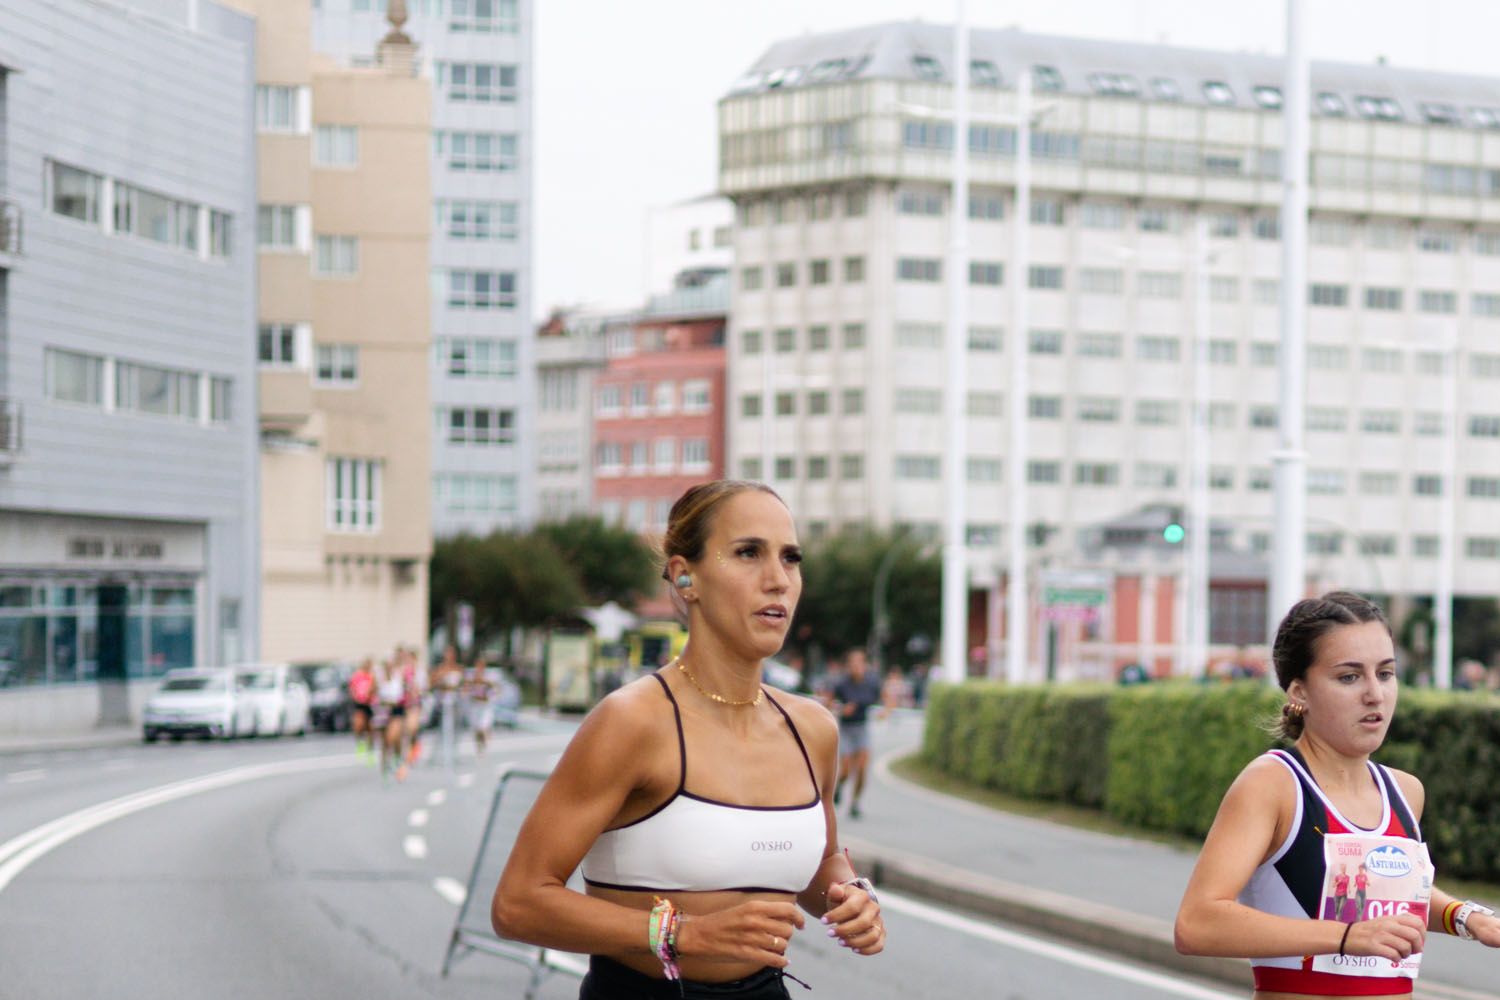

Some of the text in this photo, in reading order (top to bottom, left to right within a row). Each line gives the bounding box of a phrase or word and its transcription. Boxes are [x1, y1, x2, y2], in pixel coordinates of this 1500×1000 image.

[751, 840, 792, 851] OYSHO
[1338, 847, 1362, 857] SUMA
[1370, 857, 1410, 870] ASTURIANA
[1368, 900, 1410, 920] 016
[1333, 956, 1377, 968] OYSHO
